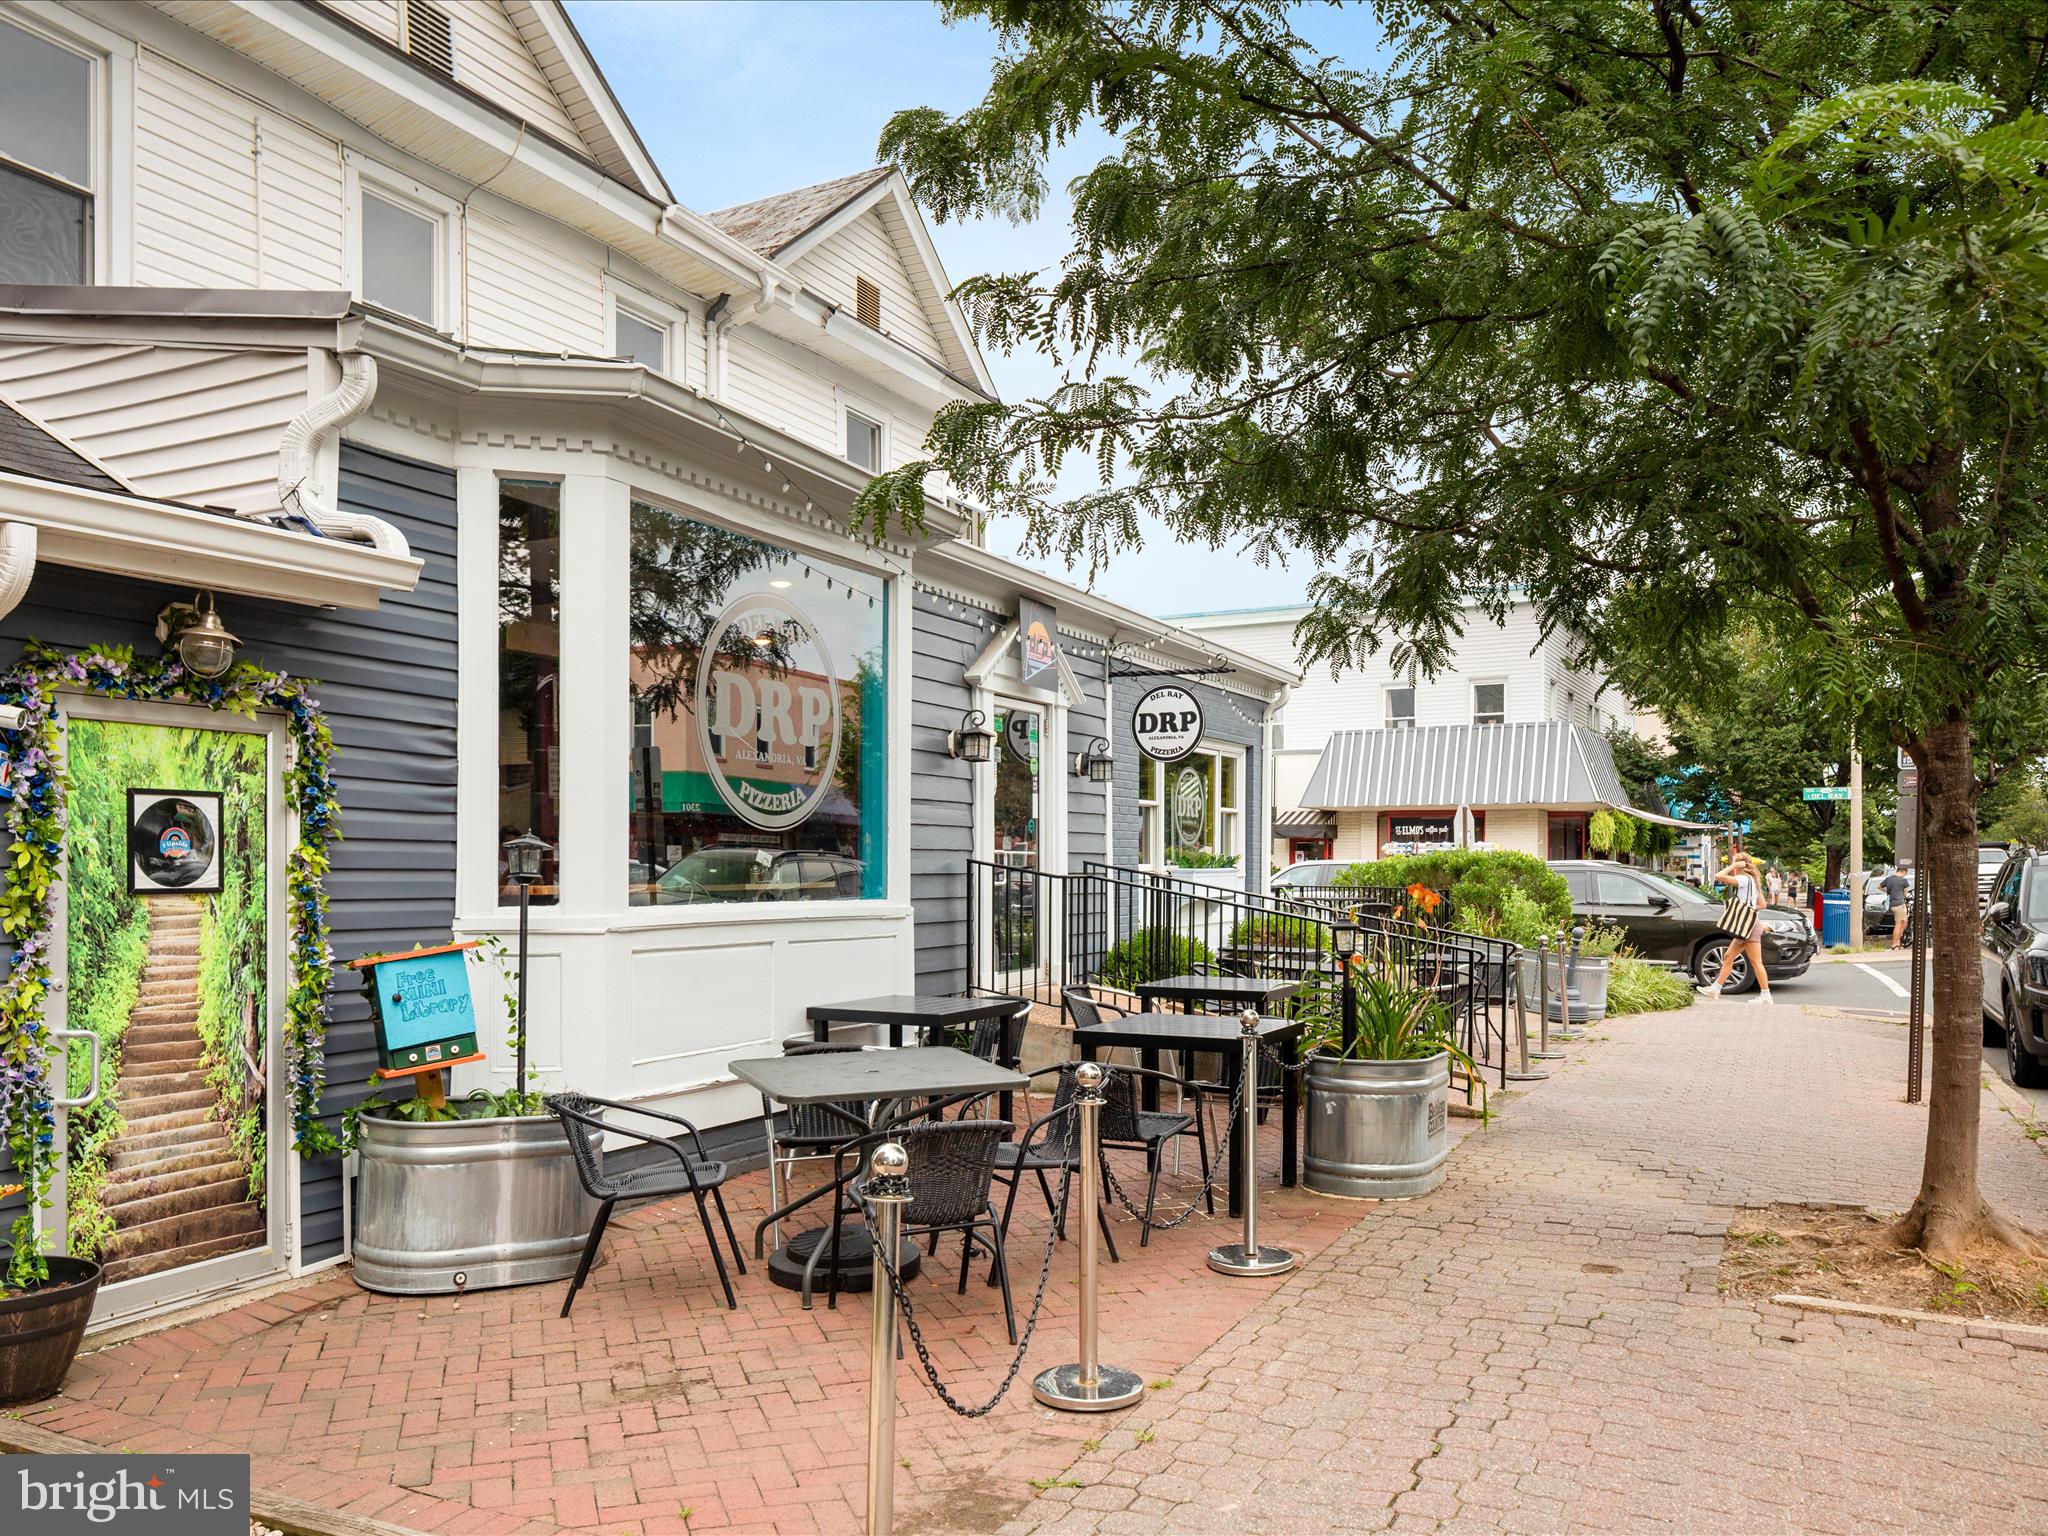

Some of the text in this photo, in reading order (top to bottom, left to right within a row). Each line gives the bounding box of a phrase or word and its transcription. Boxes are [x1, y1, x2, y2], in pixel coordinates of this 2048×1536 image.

[1150, 690, 1184, 701] DEL RAY
[712, 671, 831, 747] DRP
[1138, 711, 1197, 734] DRP
[1150, 745, 1184, 756] PIZZERIA
[738, 780, 807, 812] PIZZERIA
[1178, 795, 1202, 817] DRP
[396, 968, 436, 989] Free
[397, 979, 447, 1001] MINI
[401, 994, 470, 1022] Library
